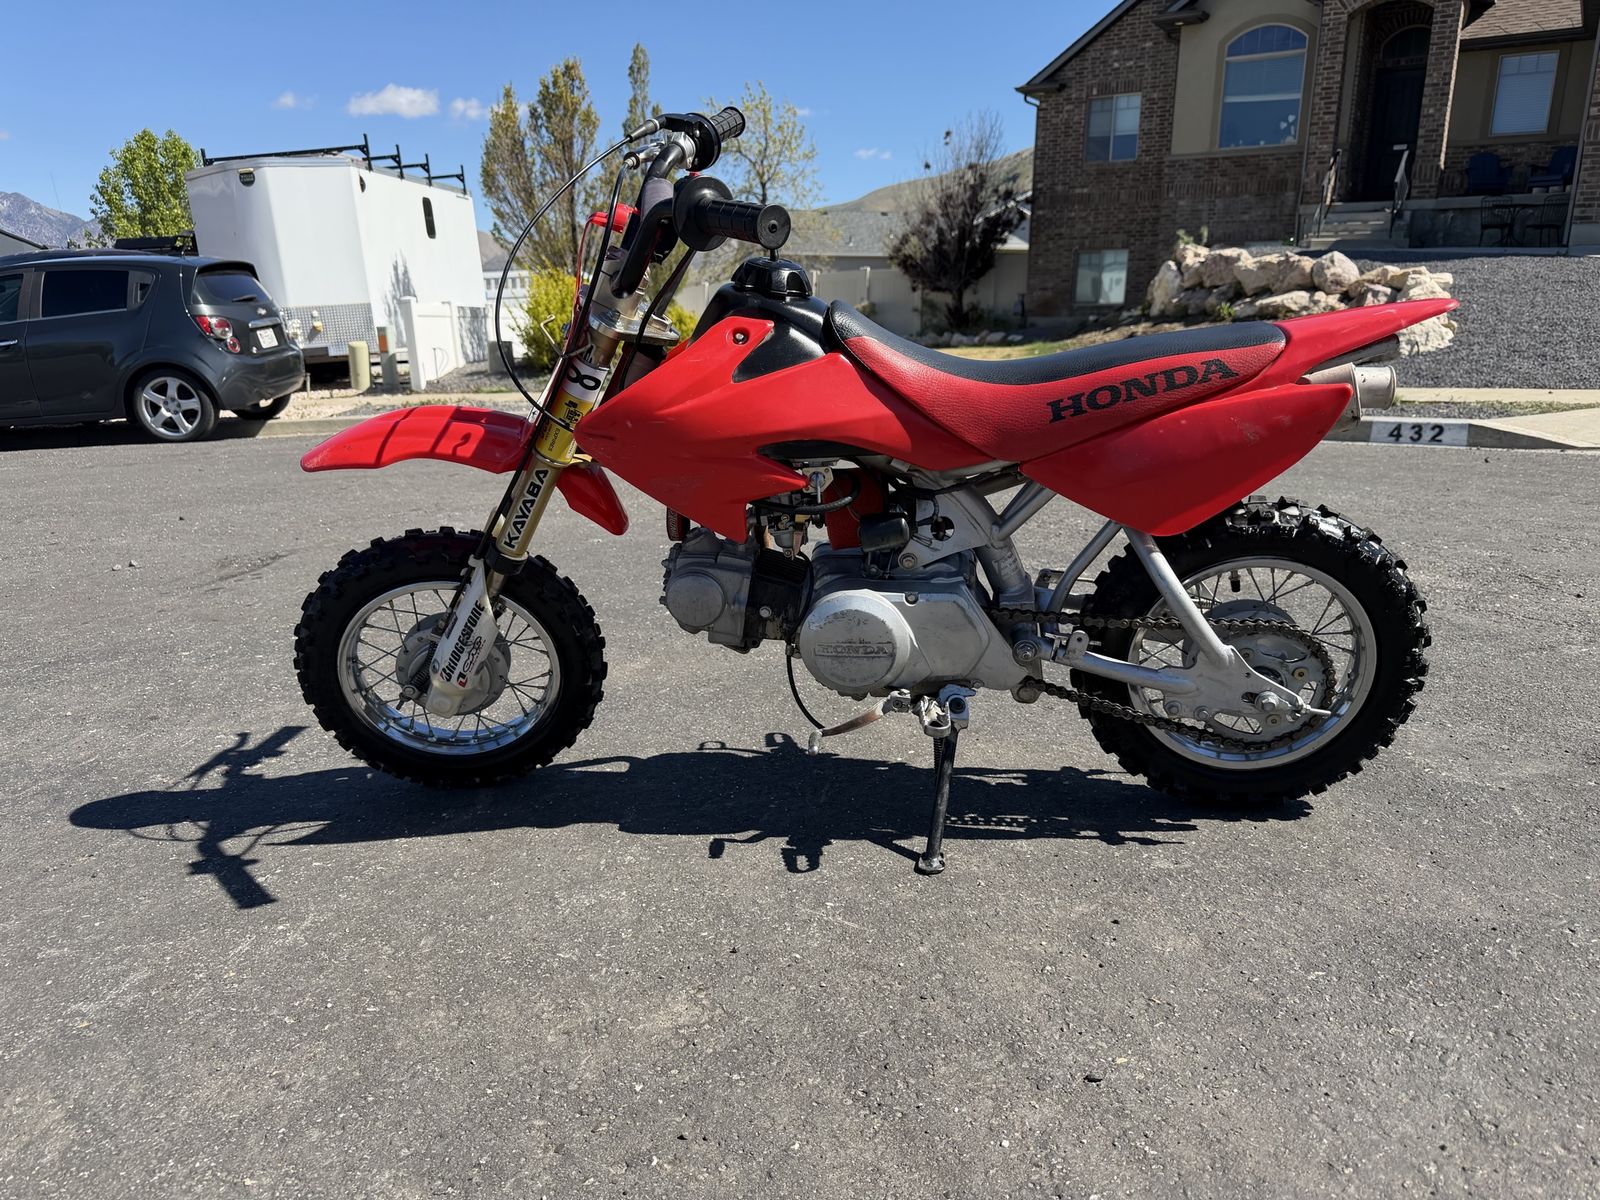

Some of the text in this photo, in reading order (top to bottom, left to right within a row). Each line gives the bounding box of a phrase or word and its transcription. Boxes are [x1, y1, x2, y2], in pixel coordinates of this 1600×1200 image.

[1046, 358, 1239, 424] HONDA
[1388, 423, 1445, 443] 432
[503, 468, 550, 550] KAYABA
[440, 600, 485, 682] BRIDGESTONE
